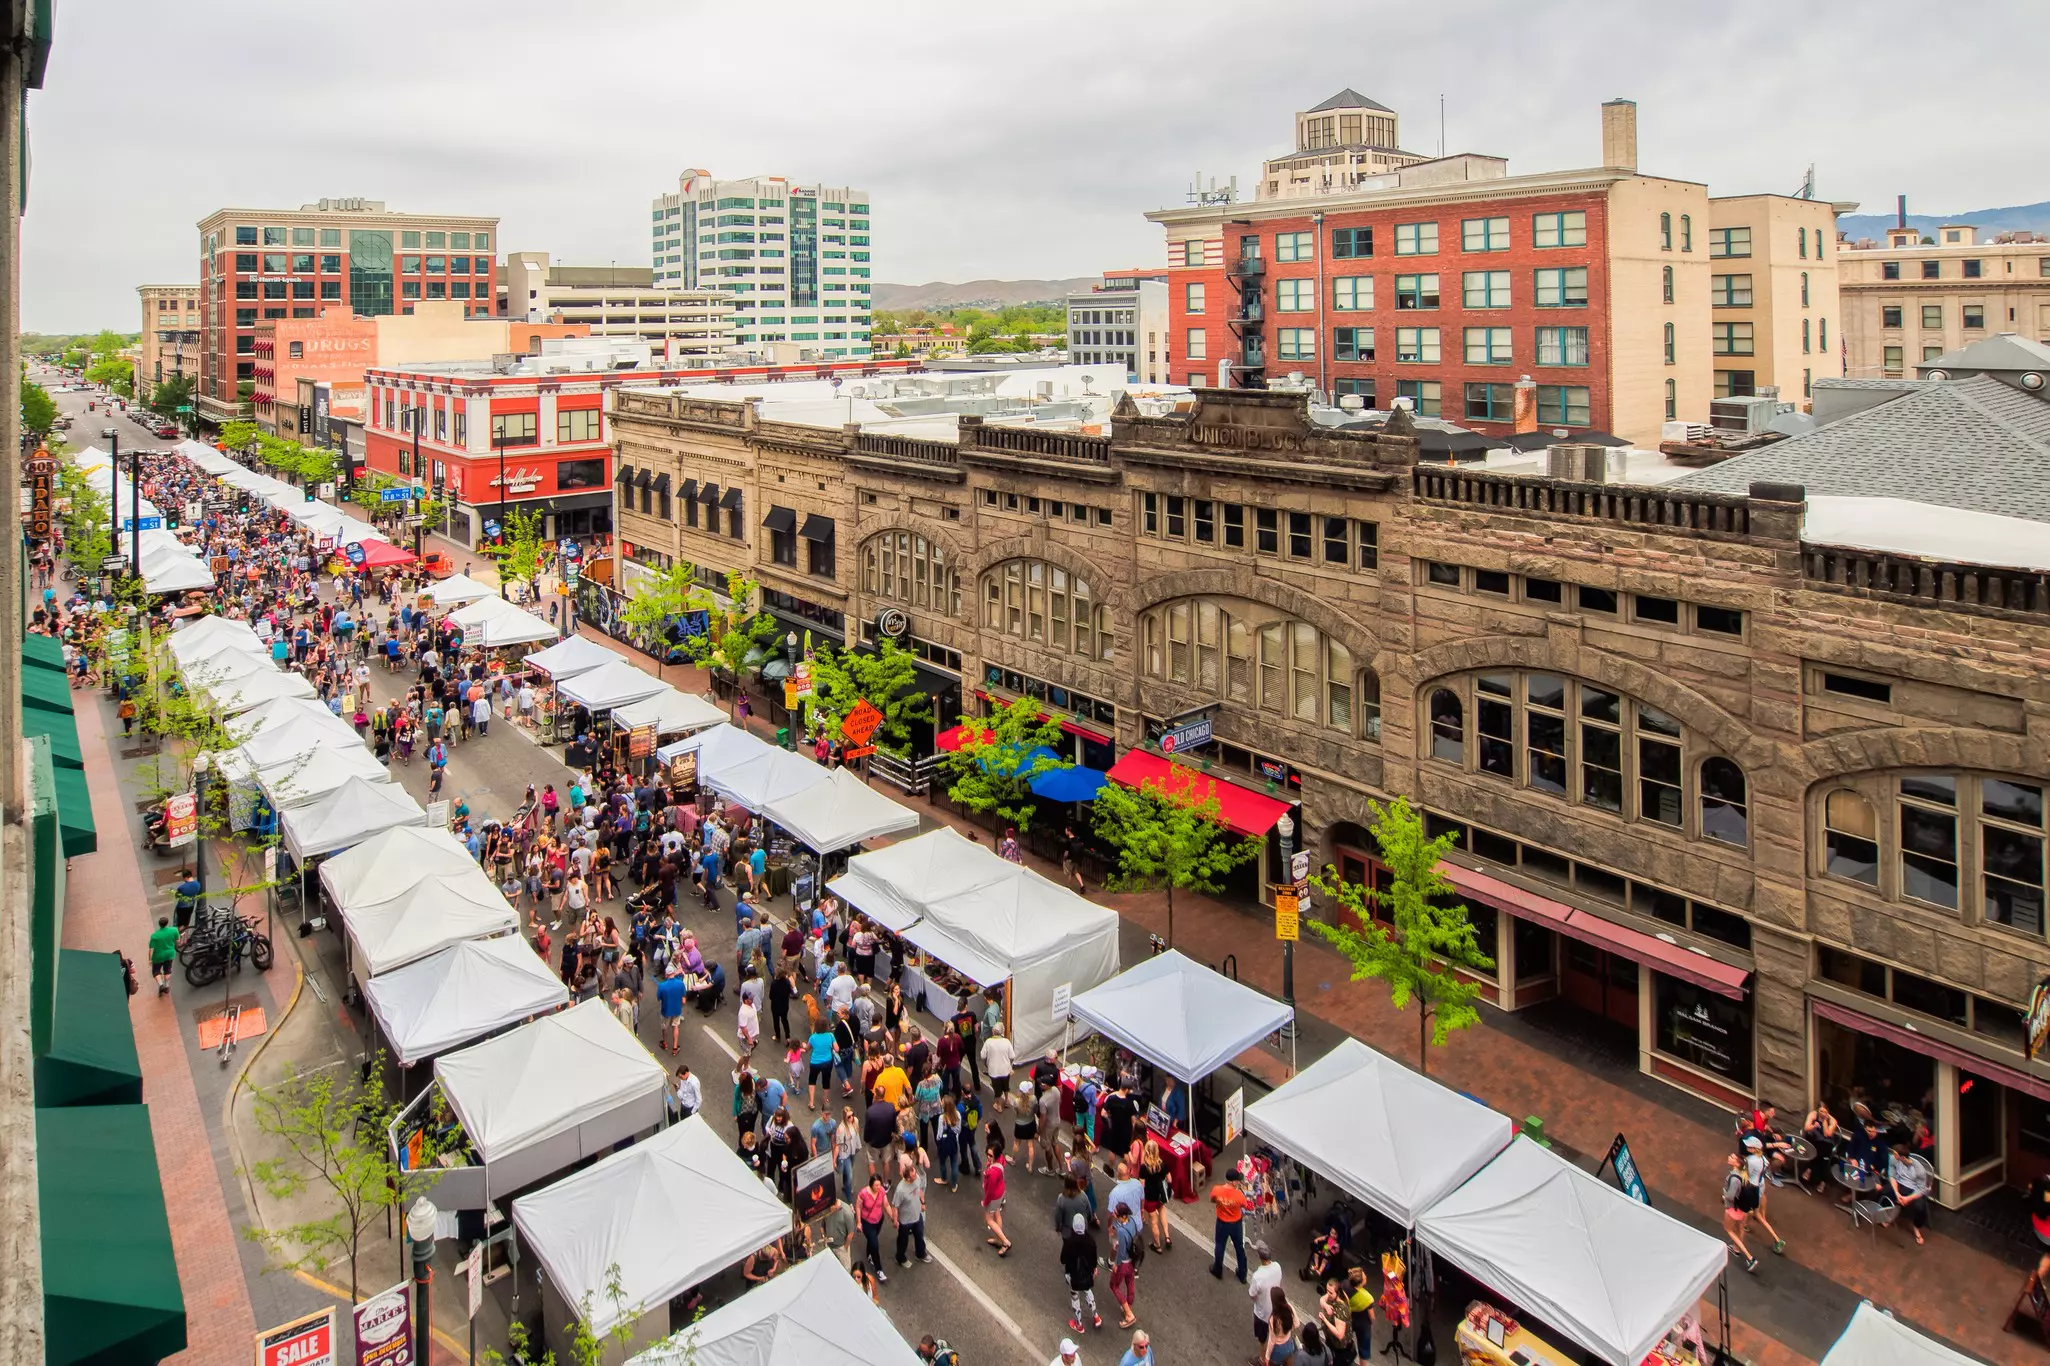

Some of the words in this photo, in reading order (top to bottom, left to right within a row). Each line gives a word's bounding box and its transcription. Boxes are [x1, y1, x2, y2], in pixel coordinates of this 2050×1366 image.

[282, 276, 303, 284] Lynch
[306, 338, 370, 353] DRUGS
[1191, 424, 1243, 447] UNION
[1246, 428, 1309, 453] BLOCK
[29, 461, 54, 472] 805
[33, 476, 49, 534] IDAHO
[320, 540, 332, 548] EBT
[854, 707, 872, 717] ROAD
[850, 715, 875, 727] CLOSED
[852, 724, 874, 735] AHEAD
[1174, 731, 1185, 746] OLD
[1185, 723, 1210, 742] CHICAGO
[1676, 1010, 1702, 1024] BALSAM
[1701, 1021, 1728, 1035] BRANDS
[359, 1303, 407, 1333] MARKET
[276, 1334, 319, 1366] SALE
